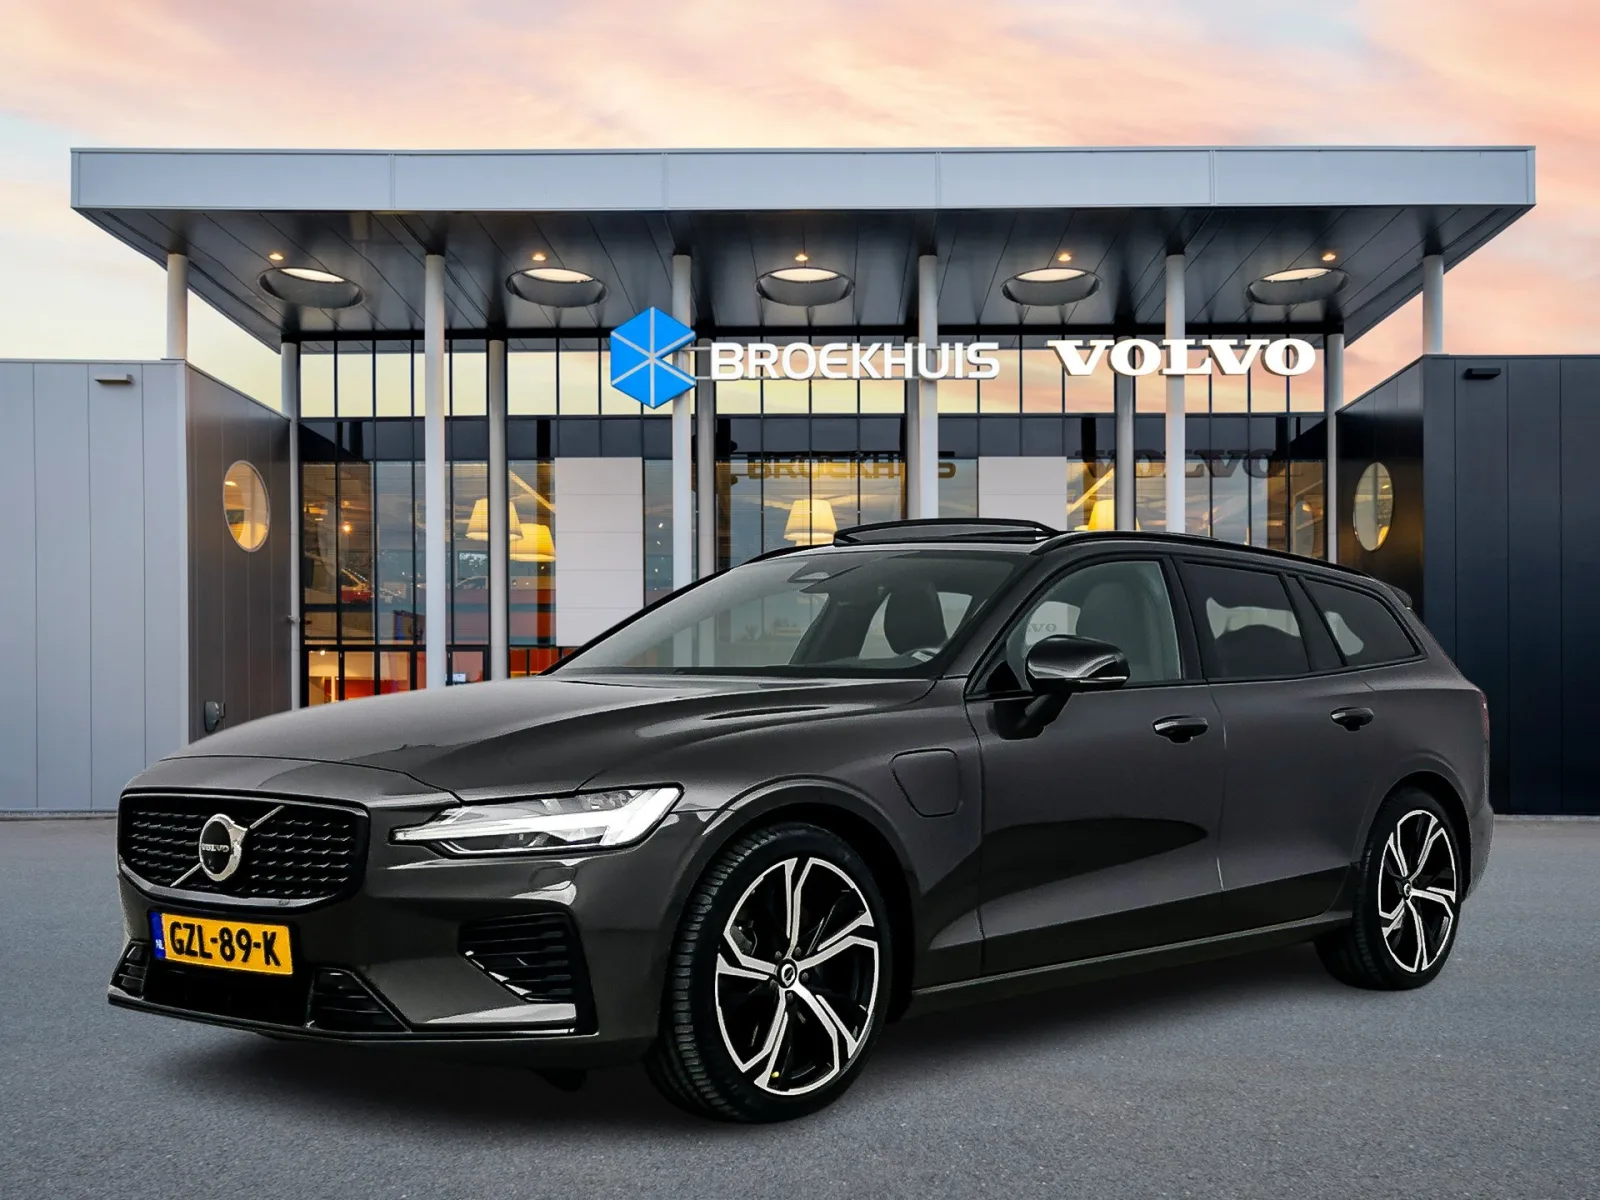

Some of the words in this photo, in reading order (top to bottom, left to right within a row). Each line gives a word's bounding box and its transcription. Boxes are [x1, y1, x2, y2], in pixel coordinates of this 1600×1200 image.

[711, 342, 1000, 379] BROEKHUIS
[1046, 338, 1316, 376] VOLVO
[748, 452, 956, 479] BROEKHS
[201, 843, 230, 852] VOLVO
[156, 939, 164, 950] NL
[170, 921, 281, 966] GZL-89-K
